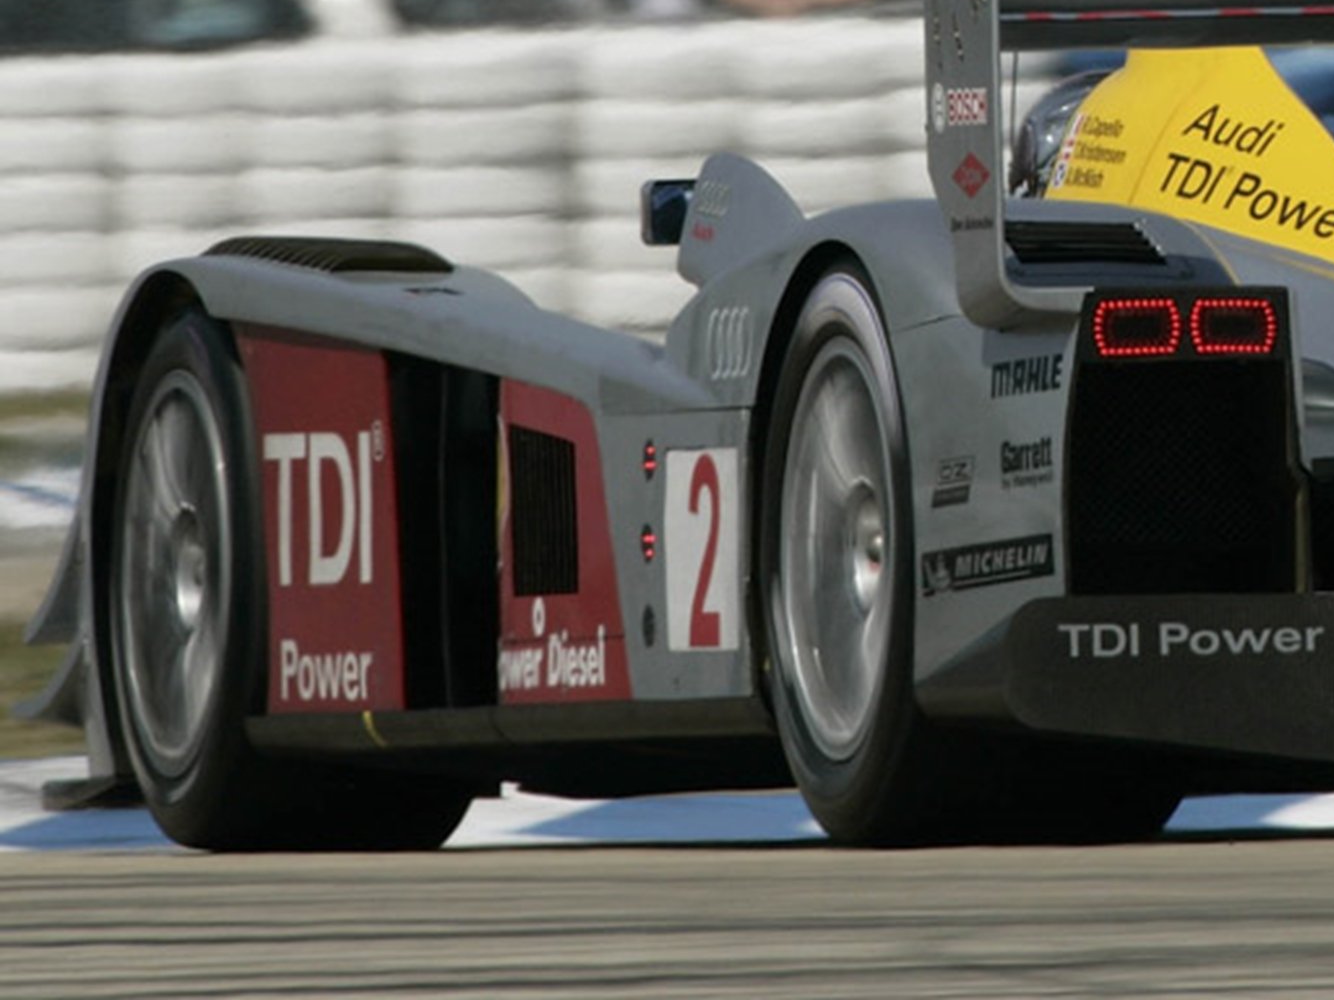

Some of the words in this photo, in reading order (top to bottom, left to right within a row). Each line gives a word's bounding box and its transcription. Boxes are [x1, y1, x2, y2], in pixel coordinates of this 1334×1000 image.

[947, 88, 988, 126] BOSCH
[1182, 104, 1285, 157] Audi
[991, 354, 1063, 398] MAHLE
[1001, 437, 1053, 474] Garrett
[688, 453, 721, 647] 2
[954, 543, 1049, 578] MICHELIN
[547, 624, 605, 687] Diesel
[1057, 623, 1140, 658] TDI
[1158, 622, 1325, 657] Power
[280, 639, 373, 701] Power
